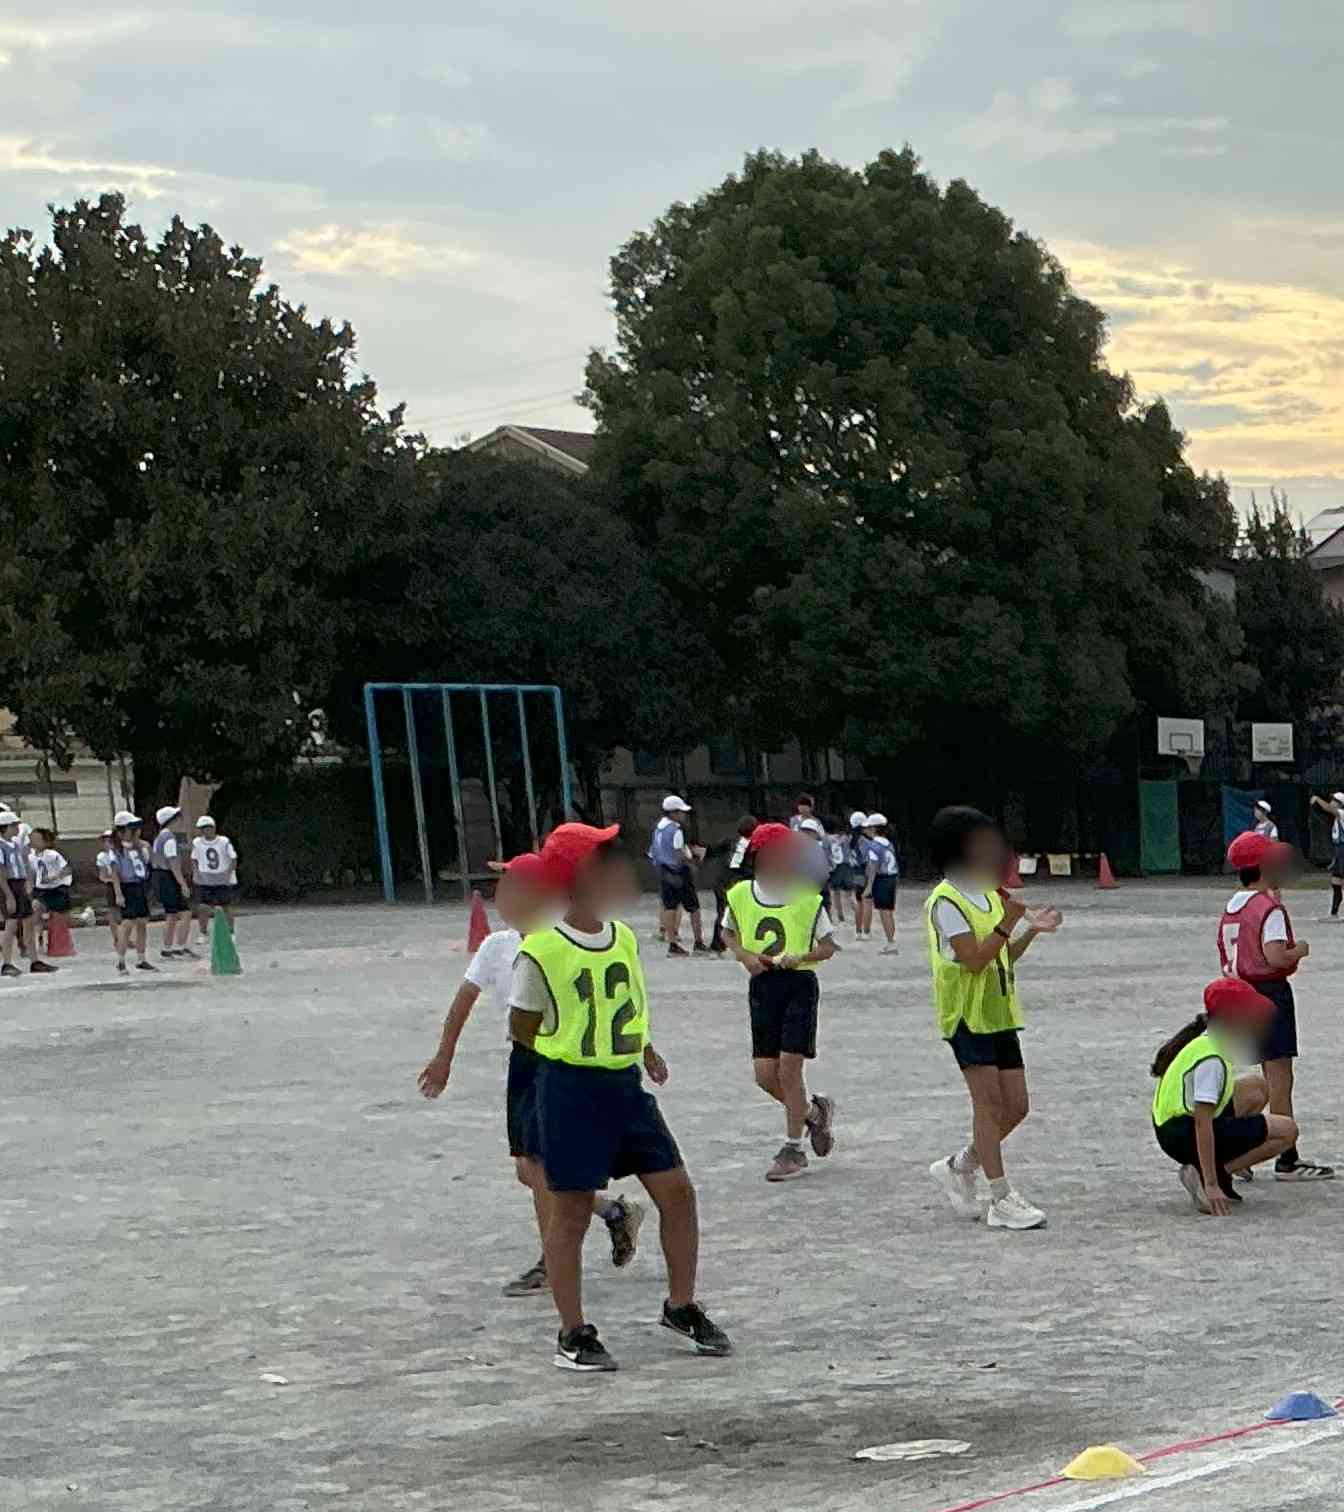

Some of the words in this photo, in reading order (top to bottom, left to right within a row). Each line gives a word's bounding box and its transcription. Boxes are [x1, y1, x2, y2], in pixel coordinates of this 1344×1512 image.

[206, 848, 220, 870] 9
[755, 916, 787, 957] 2
[1222, 922, 1241, 977] 5
[573, 961, 643, 1057] 12
